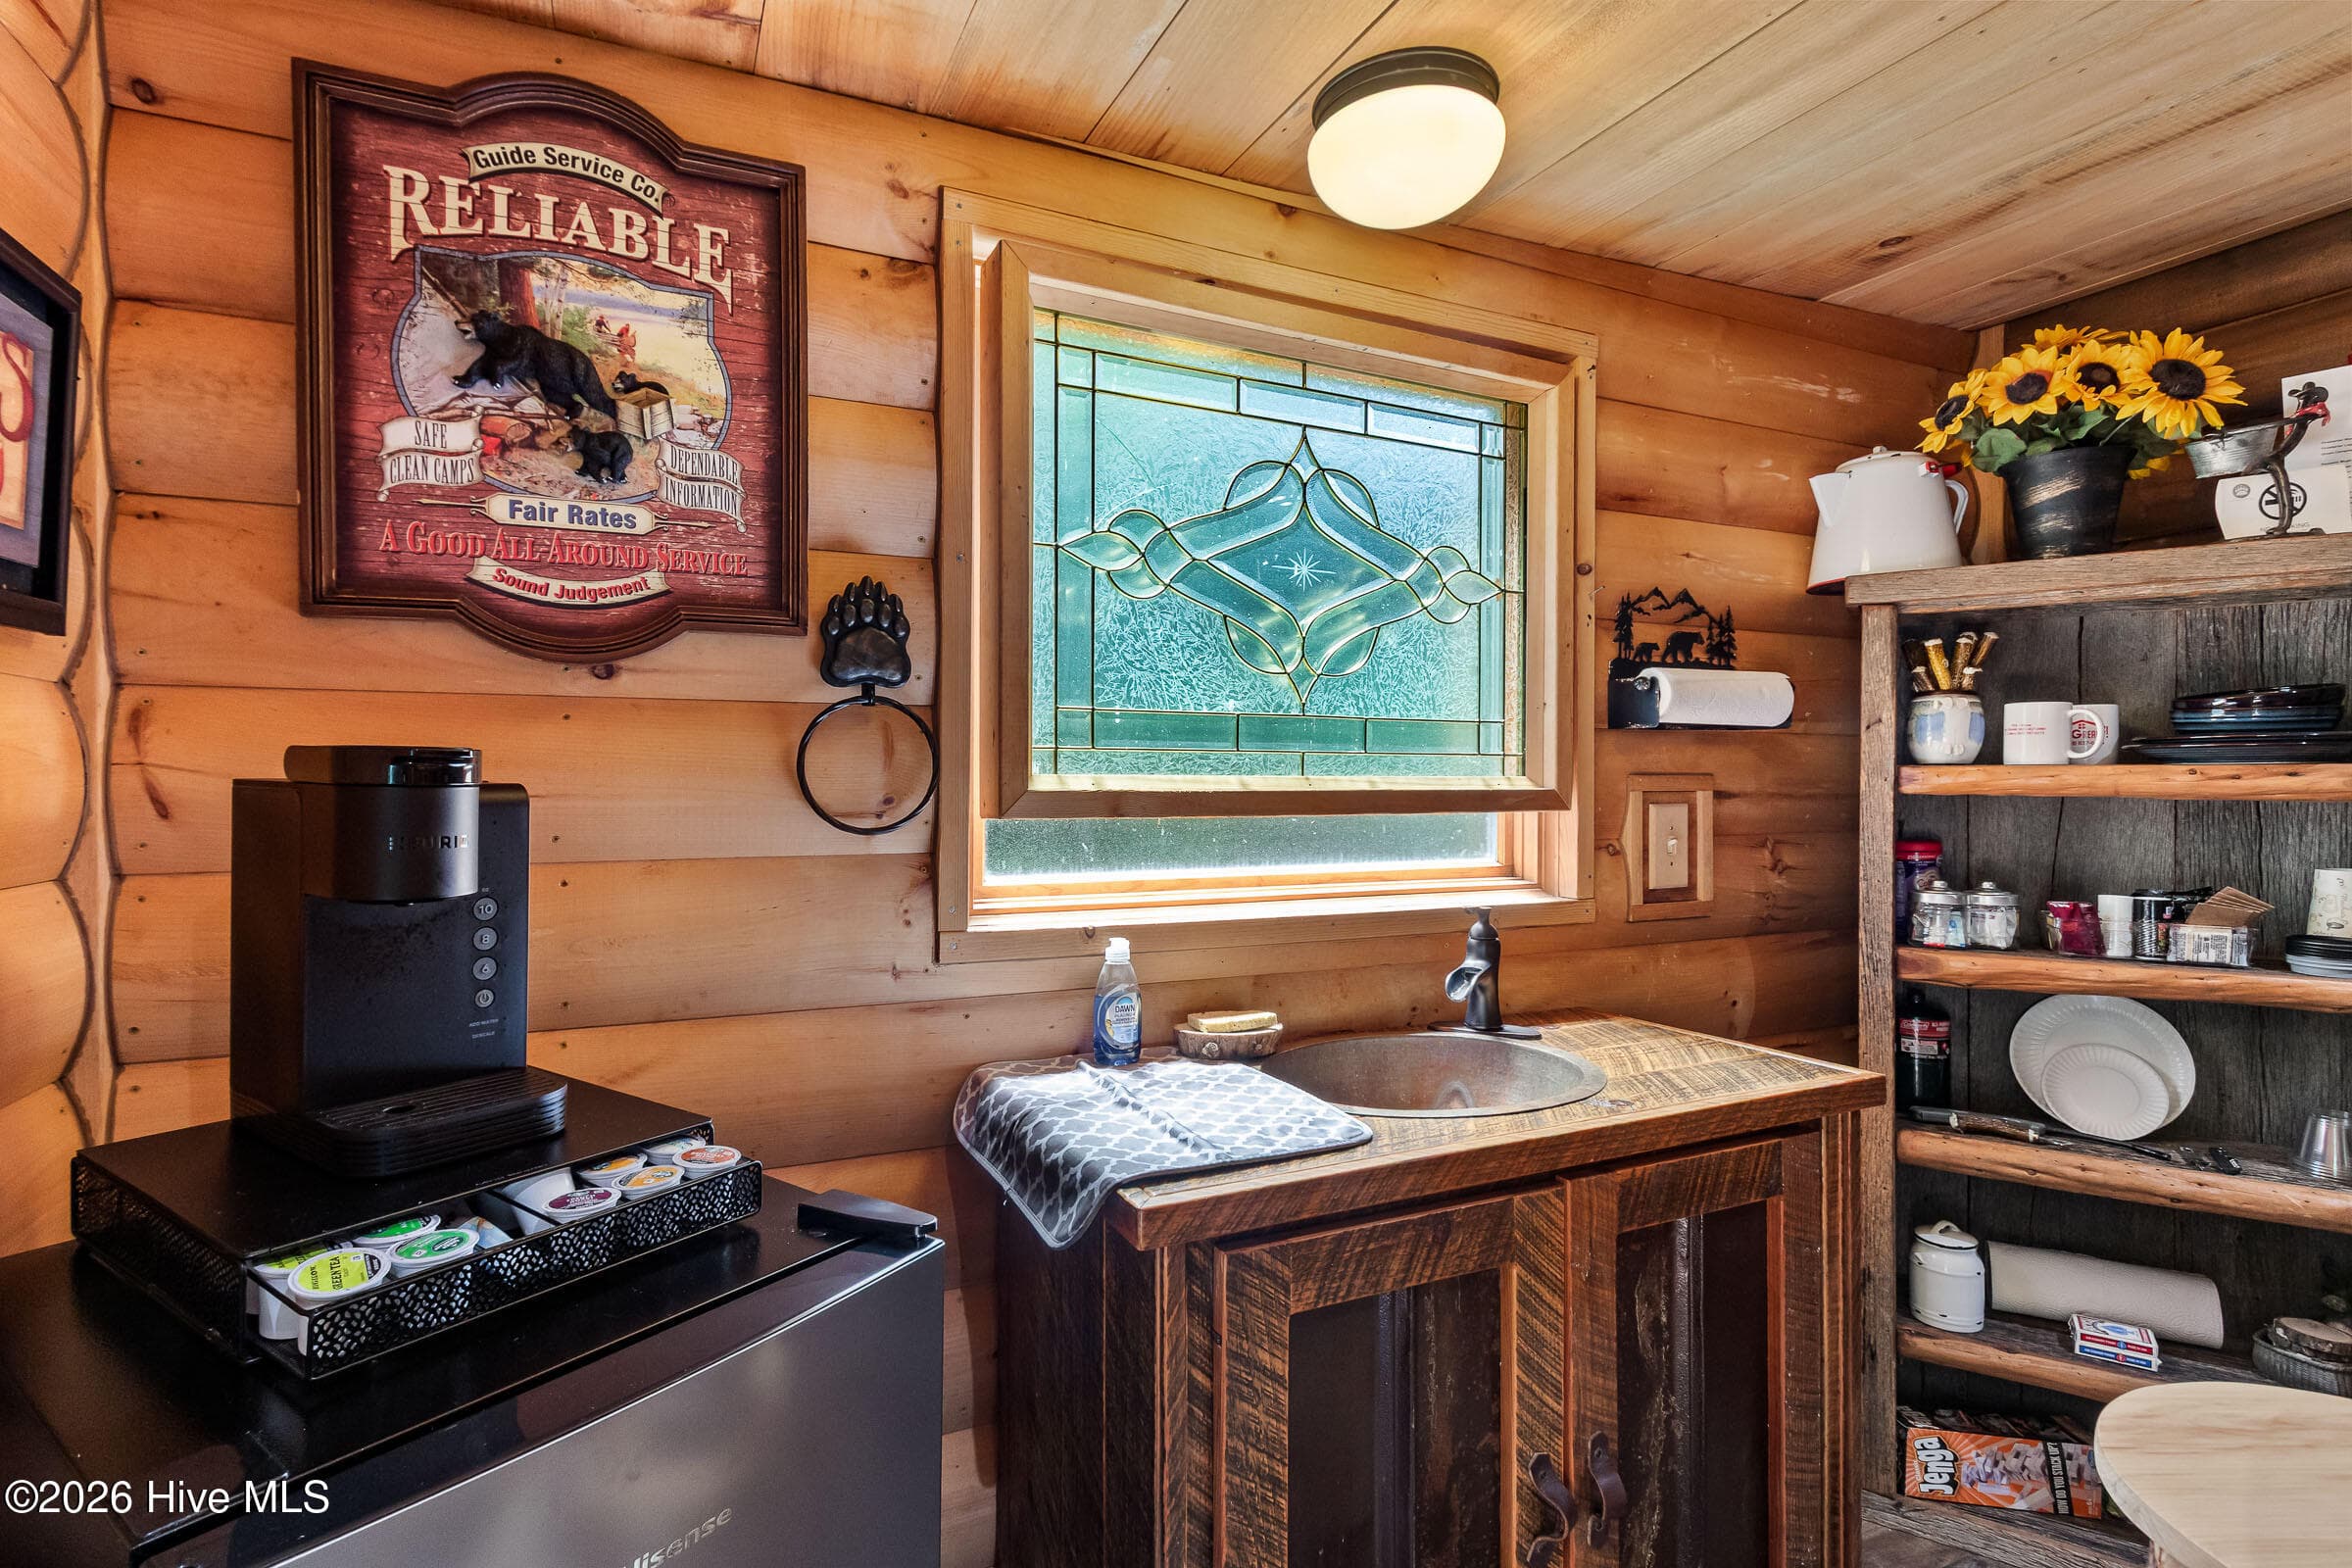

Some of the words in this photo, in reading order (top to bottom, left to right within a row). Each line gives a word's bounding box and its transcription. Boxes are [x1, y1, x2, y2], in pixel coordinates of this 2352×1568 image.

[473, 147, 537, 170] Guide
[543, 147, 624, 183] Service
[630, 172, 660, 203] Co.
[382, 165, 734, 316] RELIABLE
[415, 420, 447, 449] SAFE
[391, 457, 429, 484] CLEAN
[434, 457, 475, 483] CAMPS
[670, 448, 738, 483] DEPENDABLE
[664, 476, 739, 514] INFORMATION
[508, 499, 559, 522] Fair
[566, 503, 637, 529] Rates
[379, 519, 401, 552] A
[407, 521, 486, 558] GOOD
[655, 542, 749, 576] SERVICE
[493, 566, 550, 597] Sound
[554, 576, 651, 603] Judgement
[478, 904, 494, 915] 10
[481, 934, 491, 945] 8
[481, 963, 491, 973] 6
[1115, 1004, 1136, 1013] DAWN
[328, 1255, 341, 1270] TEA
[330, 1270, 343, 1291] GREEN
[2047, 1442, 2060, 1454] UP?
[1913, 1437, 1955, 1495] Jenga
[2050, 1455, 2064, 1476] STACK
[2052, 1475, 2066, 1490] YOU
[2054, 1489, 2067, 1499] DO
